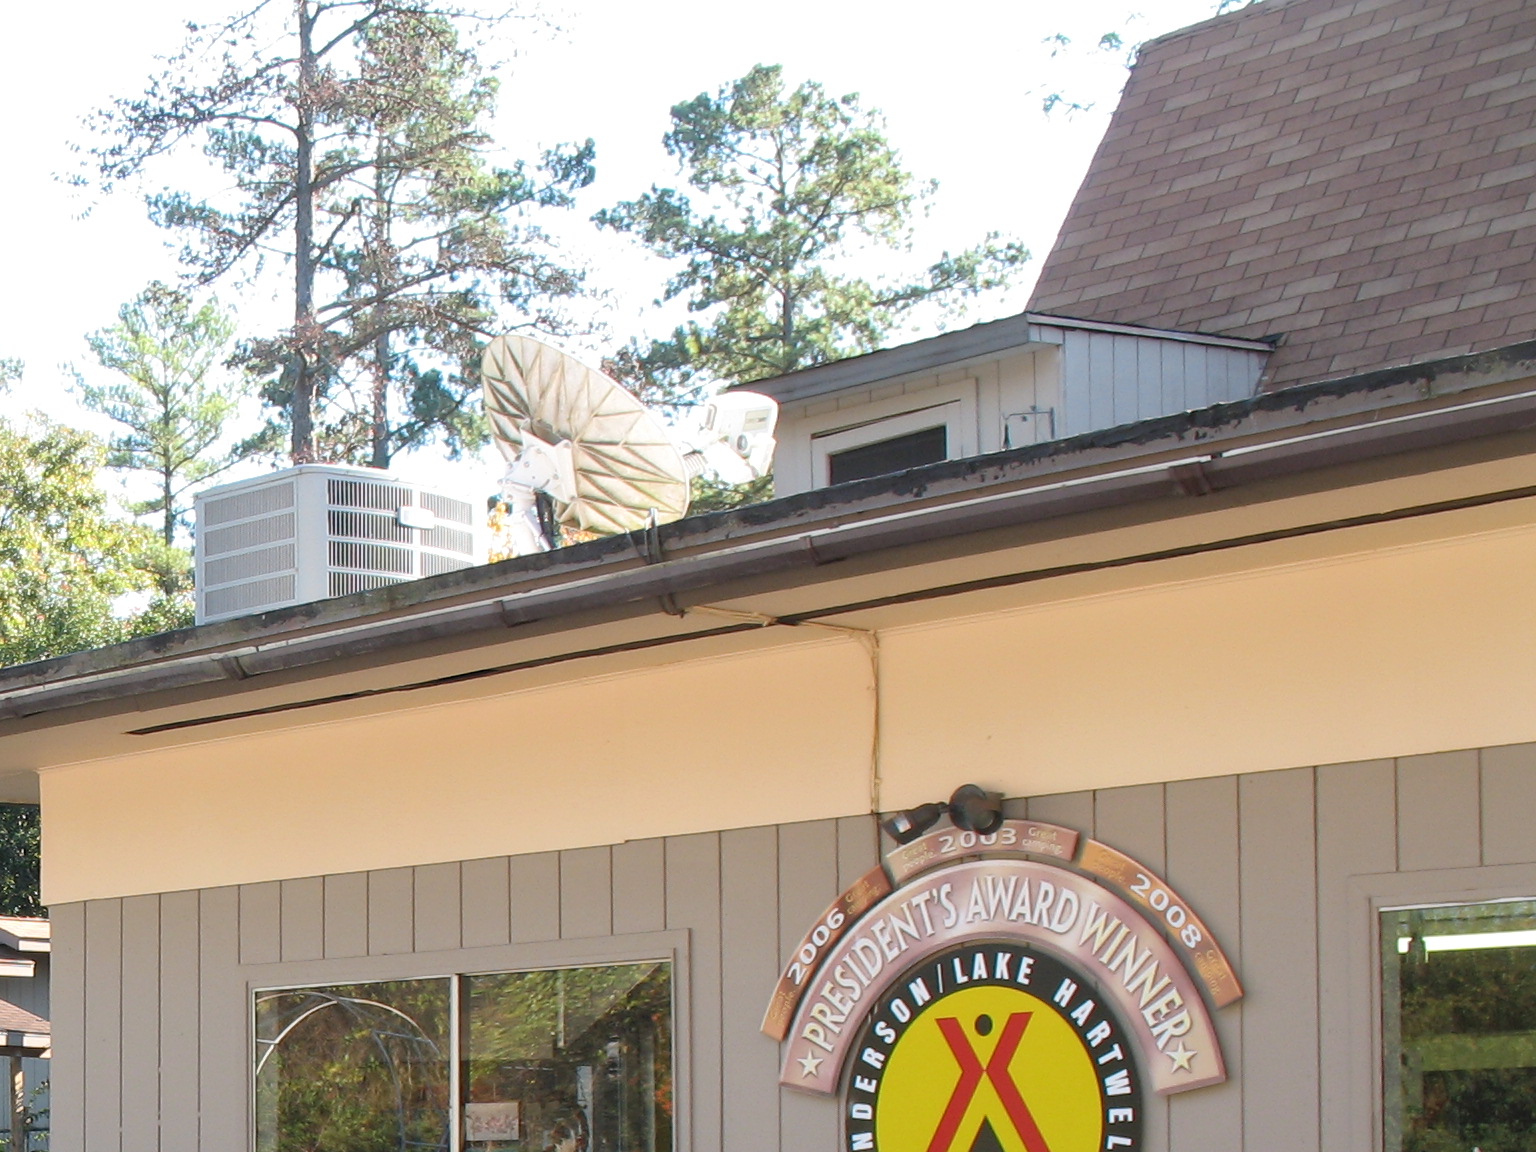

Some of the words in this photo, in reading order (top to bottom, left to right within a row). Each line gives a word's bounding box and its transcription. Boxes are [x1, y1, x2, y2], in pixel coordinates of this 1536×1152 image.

[938, 828, 1017, 854] 2003
[786, 907, 846, 986] 2006
[1130, 873, 1202, 949] 2008
[802, 882, 958, 1054] PRESIDENT'S
[966, 873, 1080, 935] AWARD
[1076, 902, 1194, 1052] WINNER
